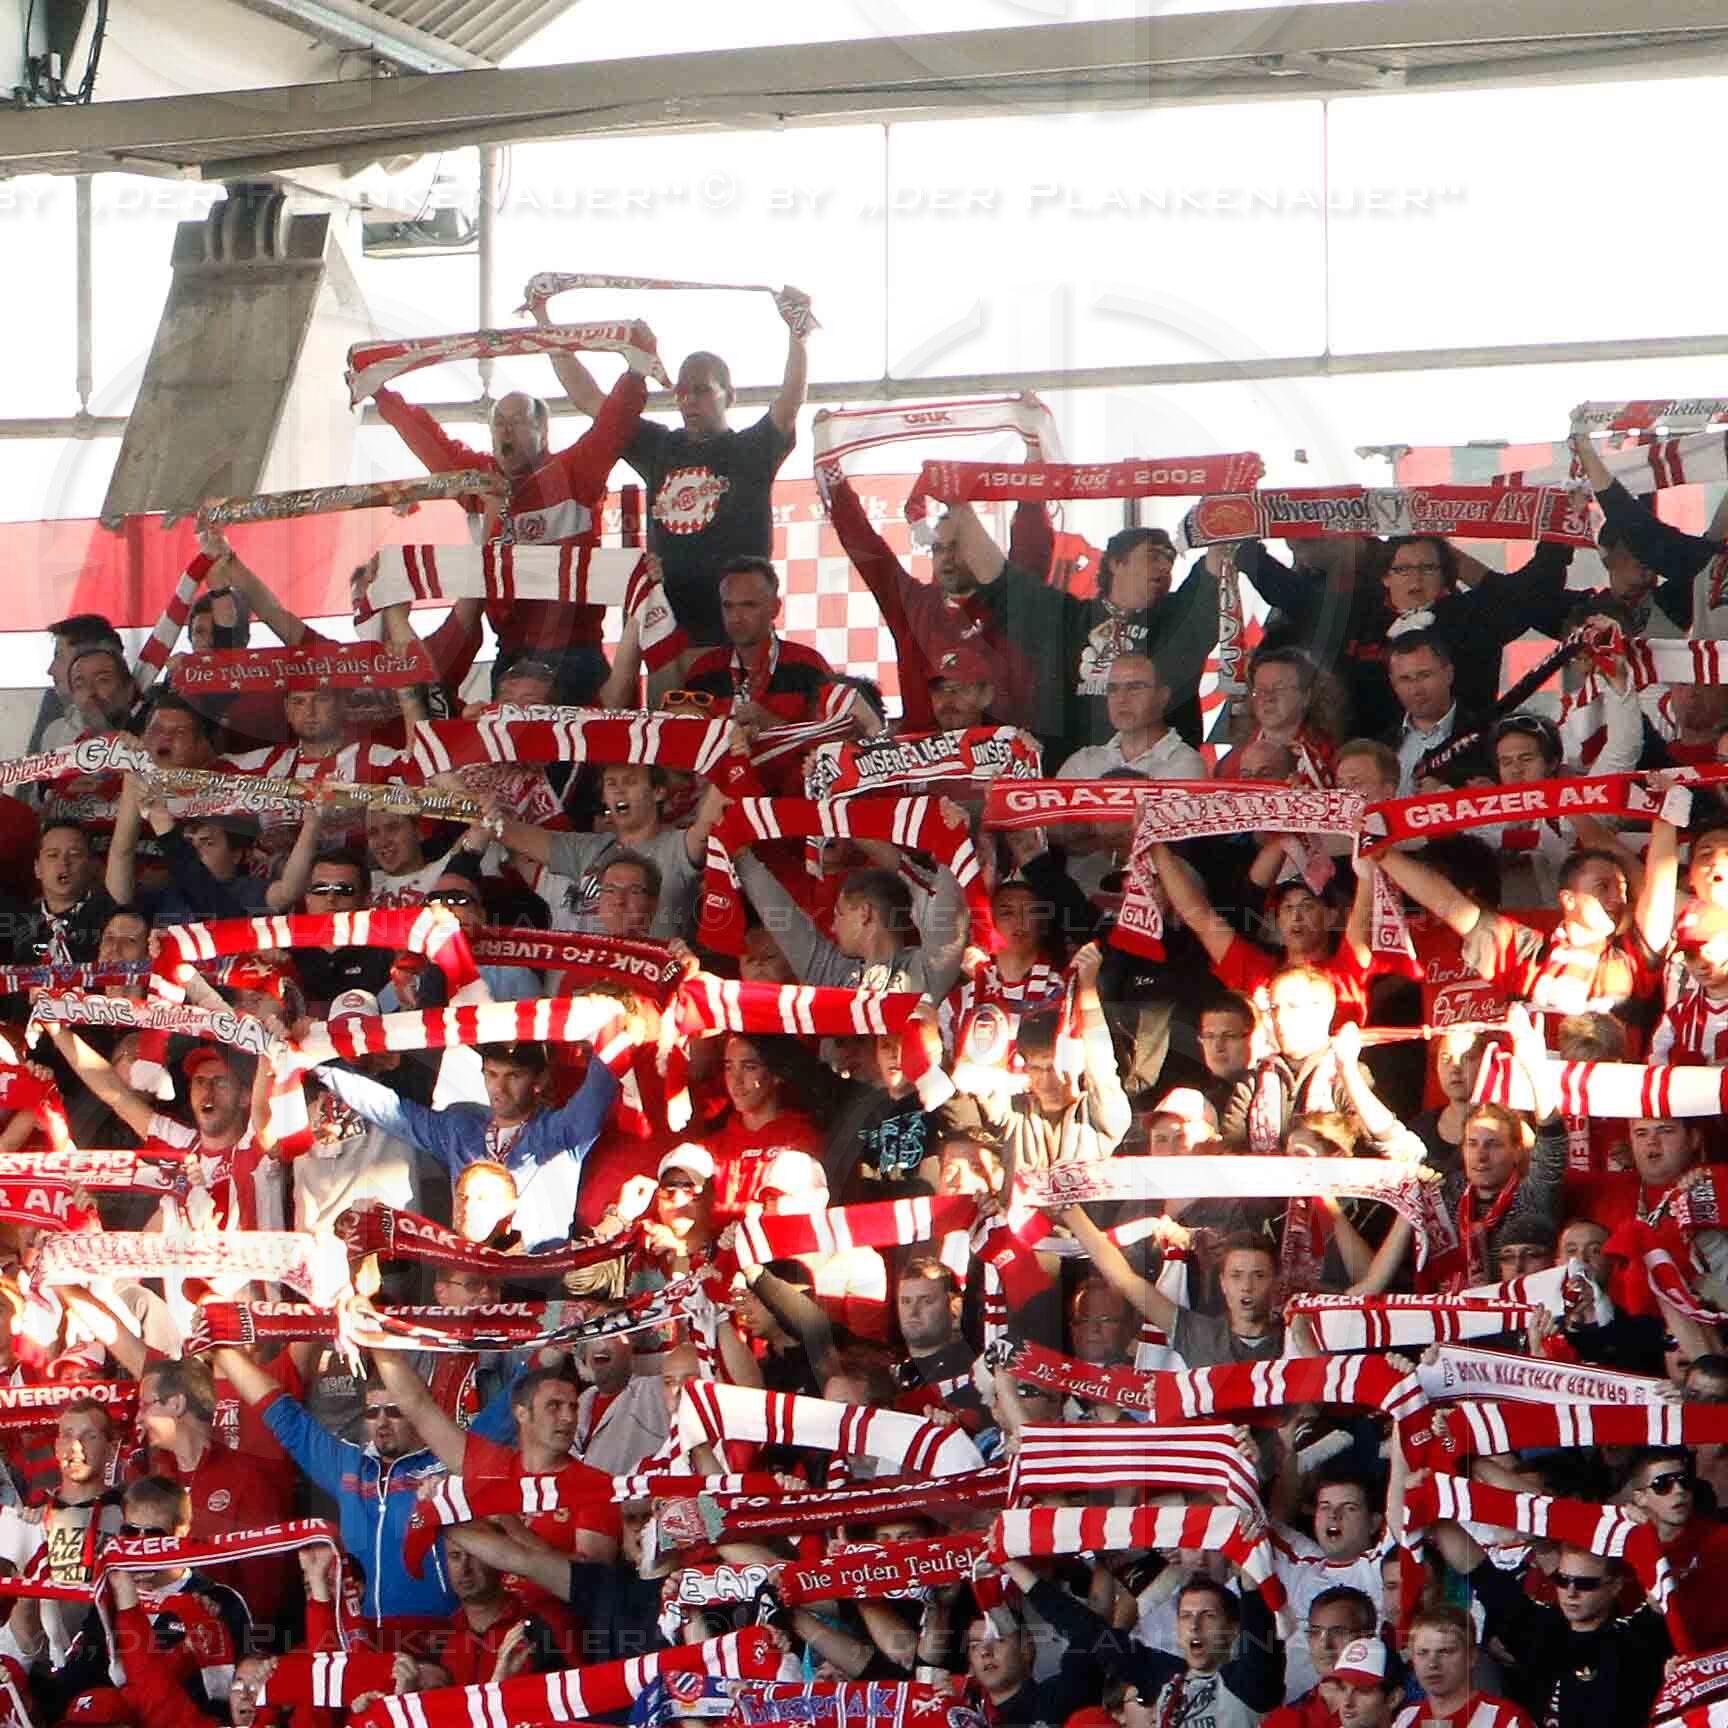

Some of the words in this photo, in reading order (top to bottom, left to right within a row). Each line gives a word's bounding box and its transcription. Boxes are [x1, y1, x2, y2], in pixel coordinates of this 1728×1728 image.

[1405, 784, 1554, 828] GRAZER
[1559, 782, 1610, 808] AK
[841, 1567, 900, 1585] roten
[907, 1550, 974, 1578] Teufel
